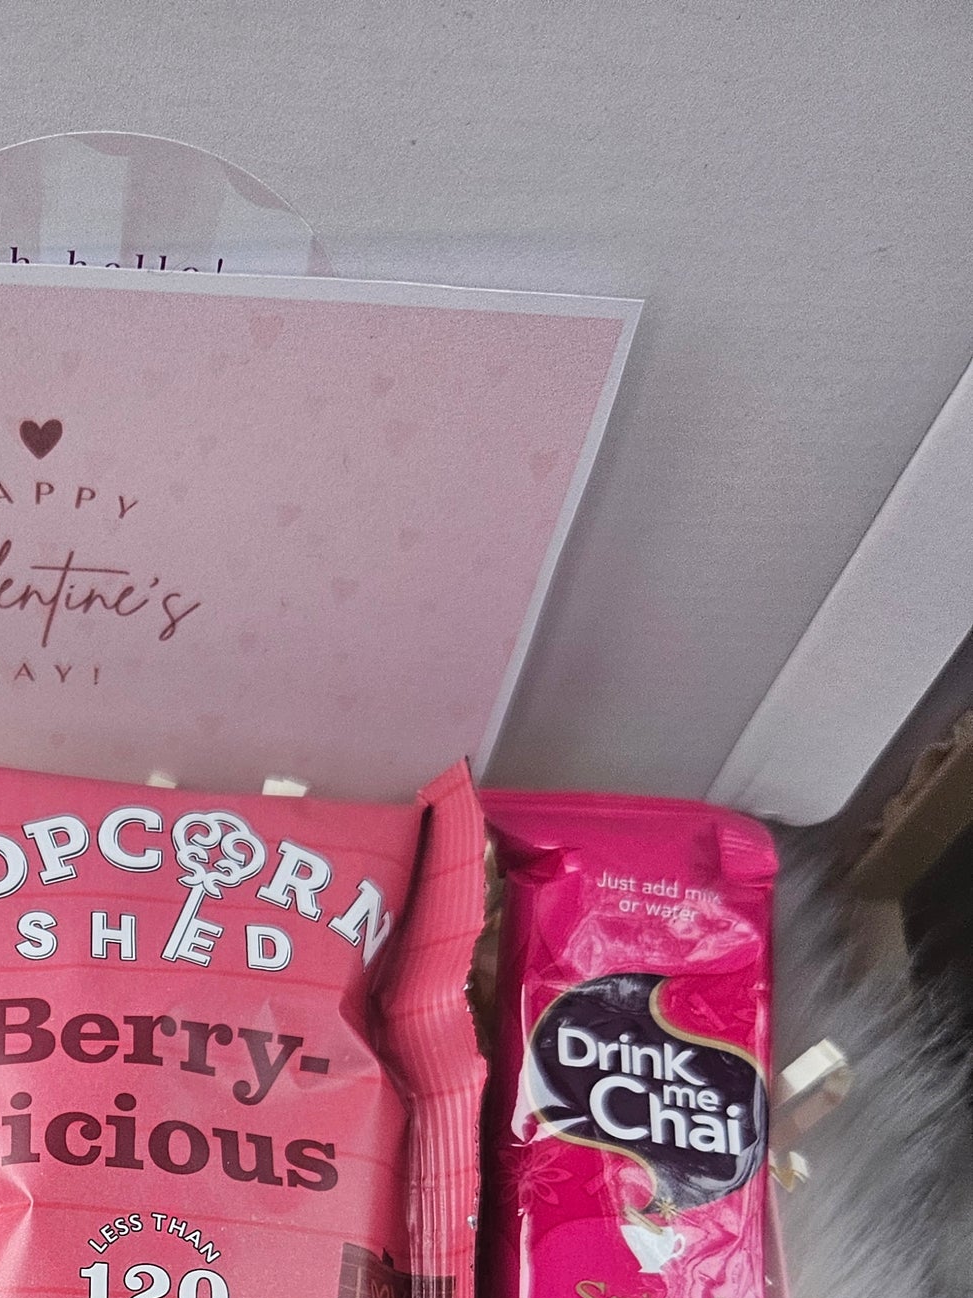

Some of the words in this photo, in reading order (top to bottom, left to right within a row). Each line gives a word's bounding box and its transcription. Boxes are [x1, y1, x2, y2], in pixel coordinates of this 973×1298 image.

[596, 872, 636, 892] Just
[642, 881, 678, 899] add
[618, 900, 638, 913] or
[645, 902, 699, 922] water
[16, 911, 292, 971] SHED
[558, 1027, 707, 1086] Drink
[589, 1075, 742, 1156] Chai
[662, 1083, 719, 1111] me
[88, 1214, 143, 1254] LESS
[151, 1212, 221, 1264] THAN
